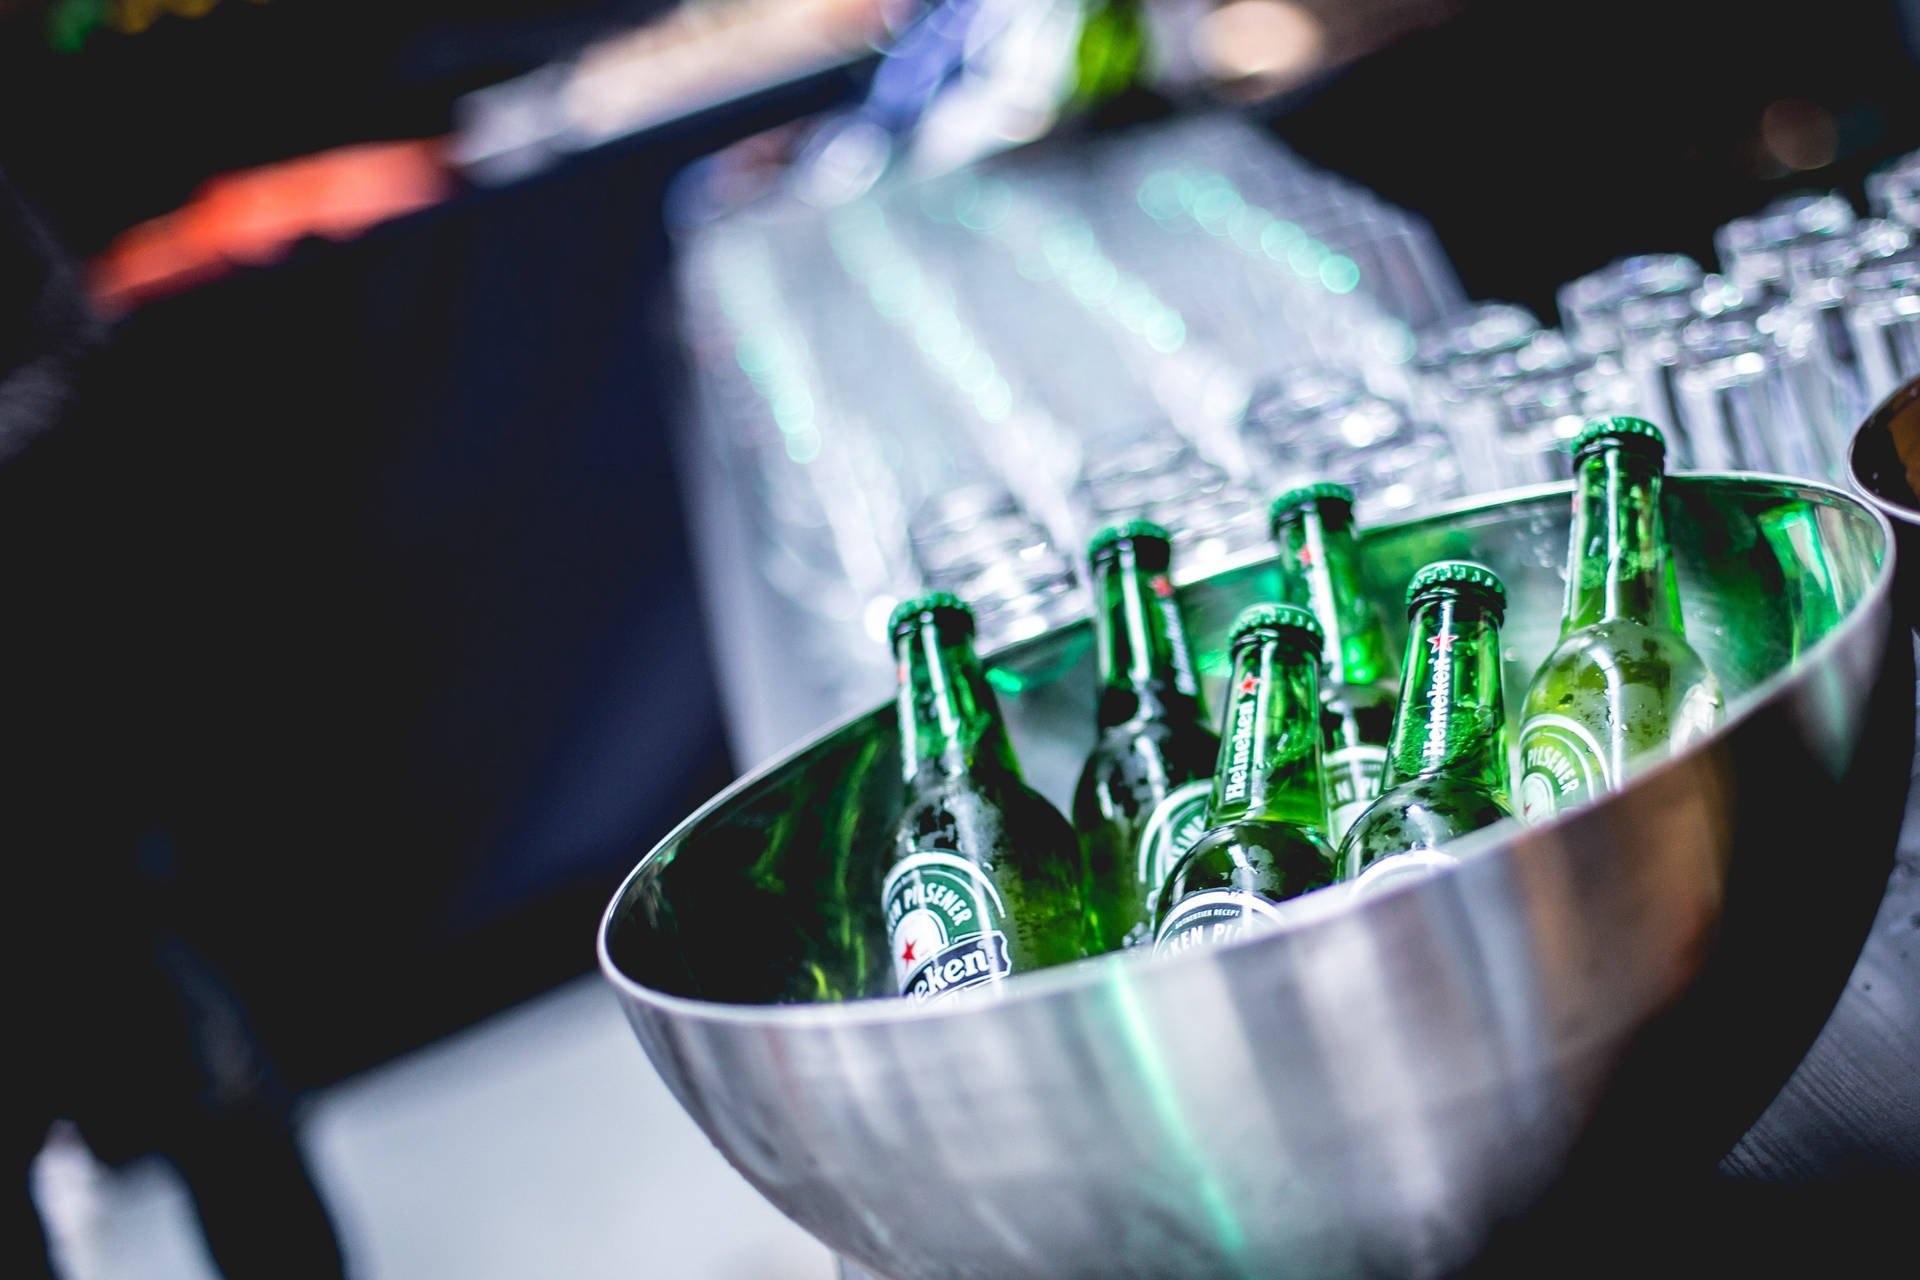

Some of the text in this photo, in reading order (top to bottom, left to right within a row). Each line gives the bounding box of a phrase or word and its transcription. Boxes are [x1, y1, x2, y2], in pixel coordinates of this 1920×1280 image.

[1422, 657, 1451, 757] Heineken
[1223, 700, 1255, 801] Heineken
[1526, 745, 1579, 796] PILSENER
[903, 882, 973, 926] PILSENER
